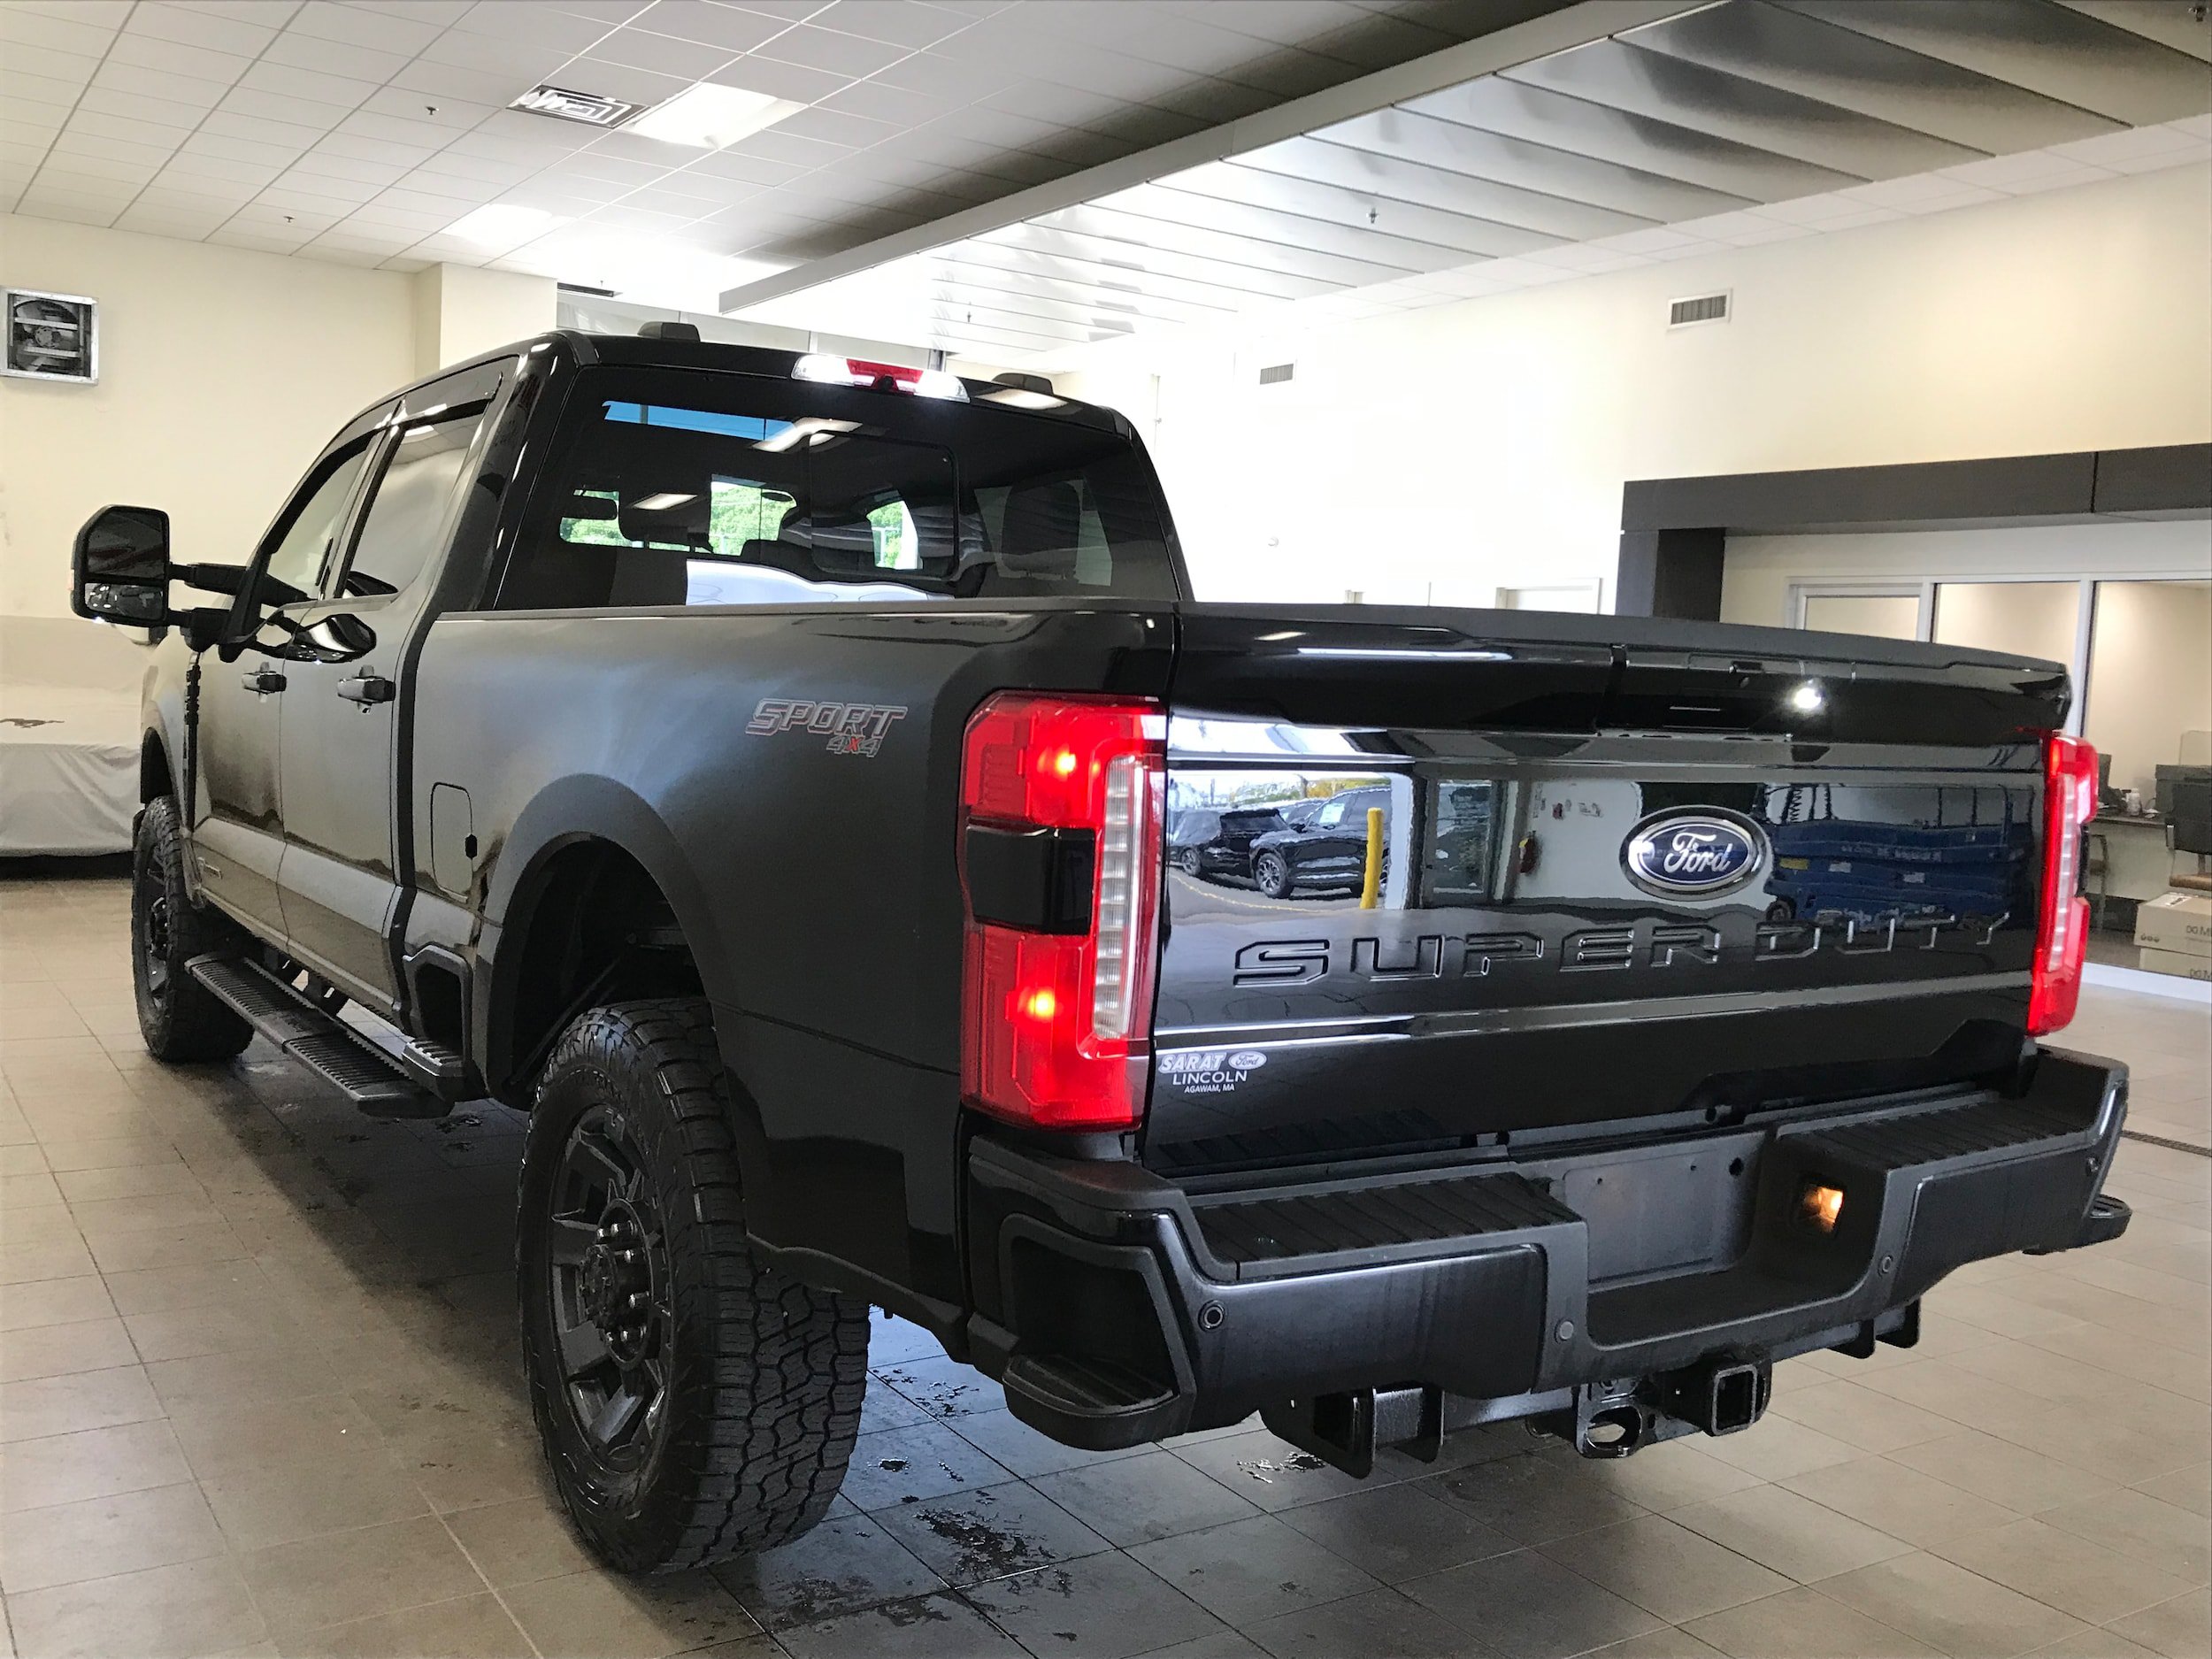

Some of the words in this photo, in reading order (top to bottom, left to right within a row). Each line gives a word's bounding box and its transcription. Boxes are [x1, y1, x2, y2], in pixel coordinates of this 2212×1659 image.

[745, 697, 909, 738] SPORT
[1663, 832, 1733, 873] Ford
[1233, 924, 1721, 988] SUPER
[1755, 911, 2010, 962] DUTY
[1158, 1052, 1227, 1073] SARAT
[1172, 1071, 1248, 1085] LINCOLN
[1184, 1085, 1221, 1094] AGAWAM,
[1222, 1083, 1235, 1092] MA
